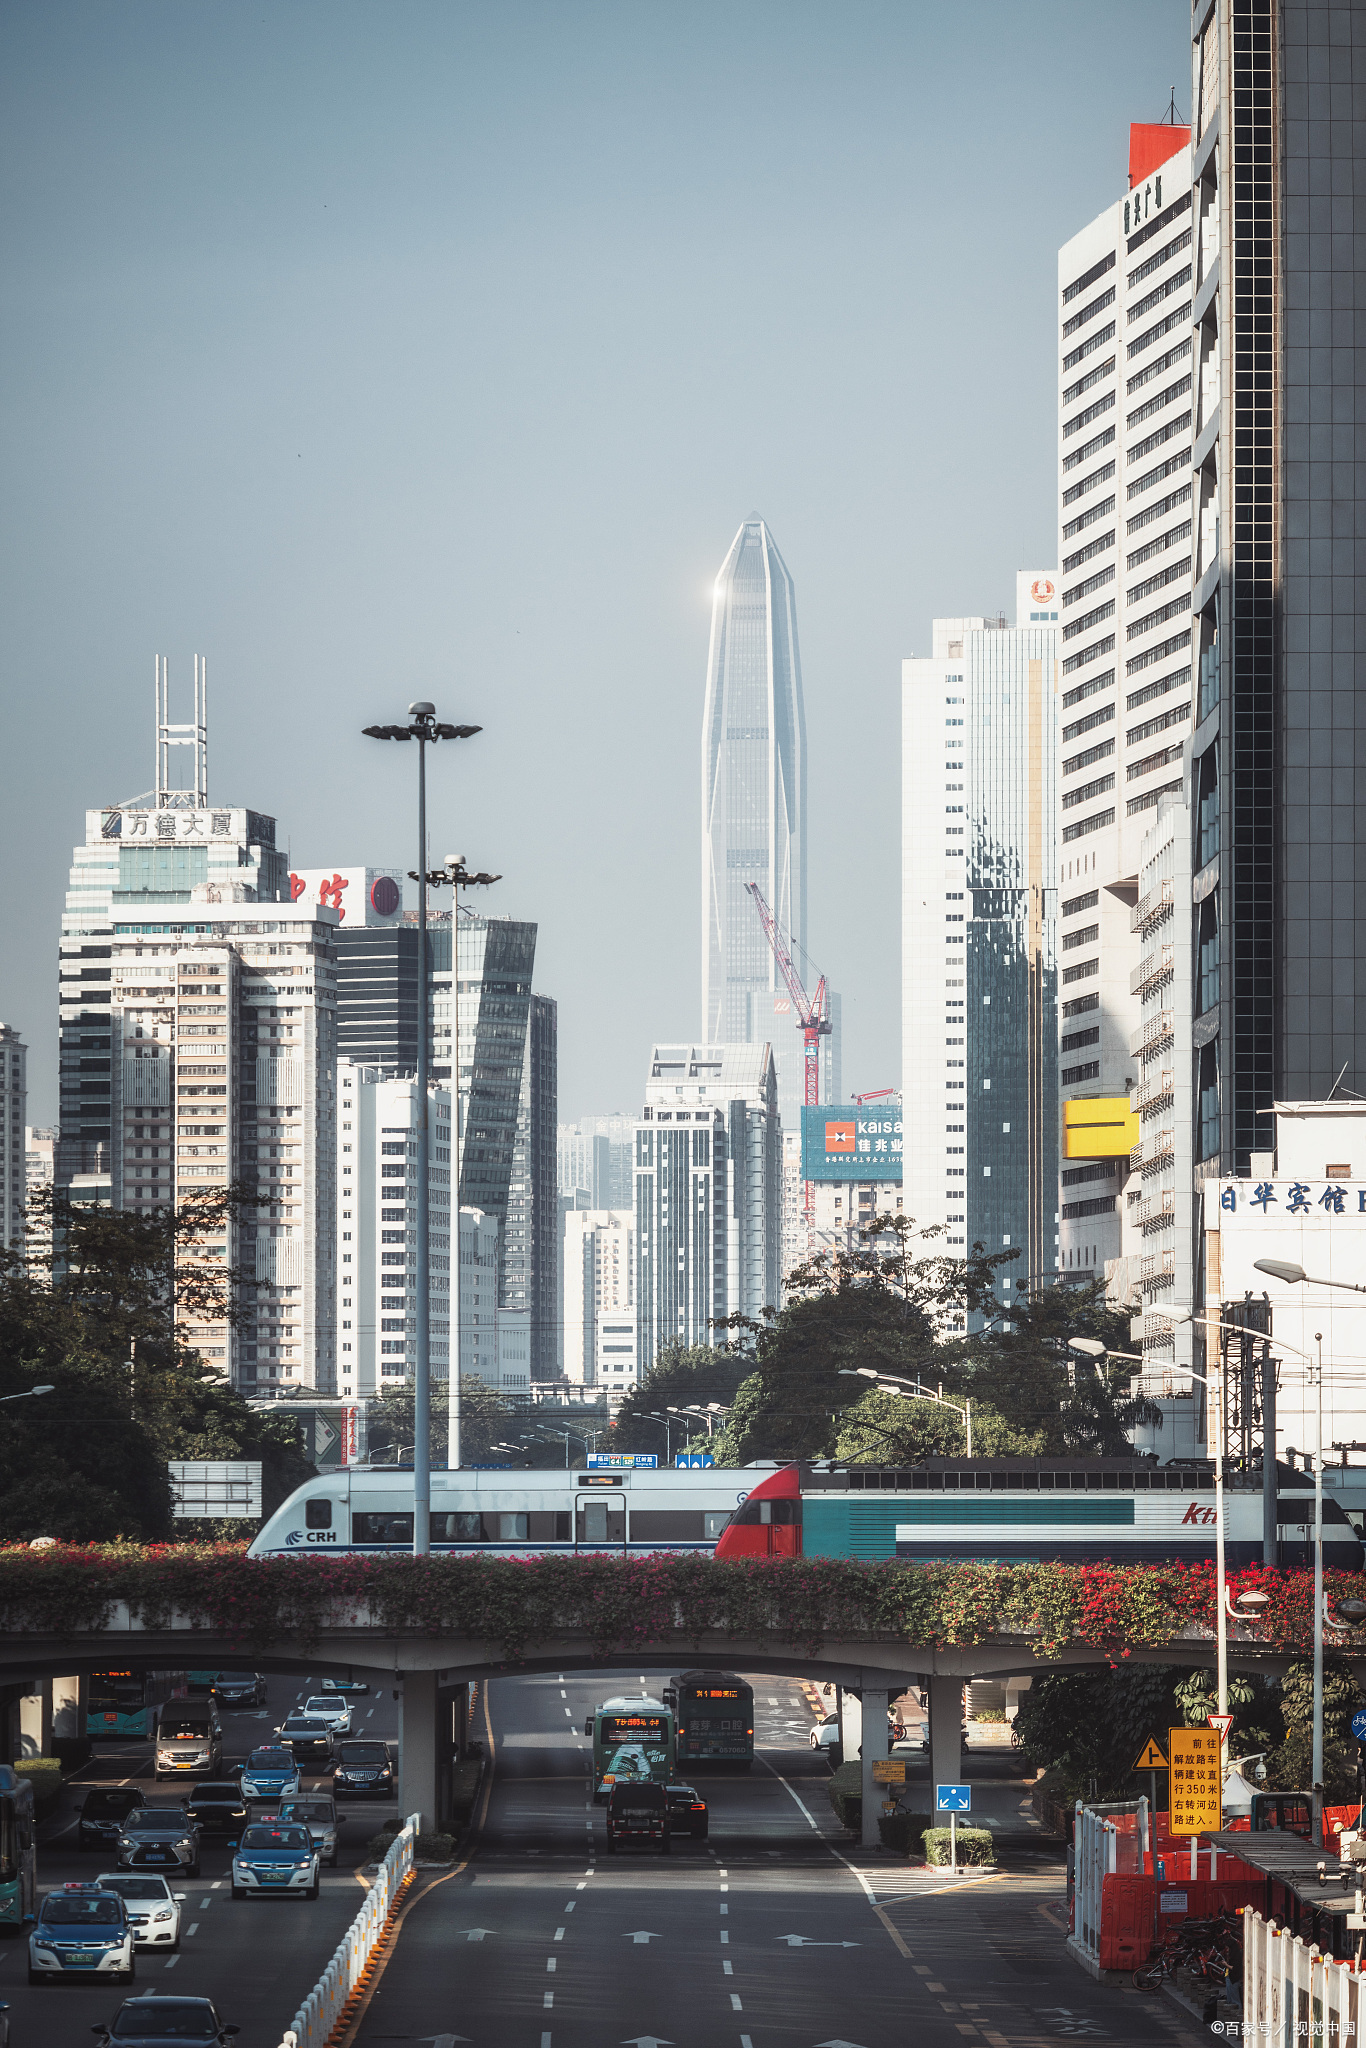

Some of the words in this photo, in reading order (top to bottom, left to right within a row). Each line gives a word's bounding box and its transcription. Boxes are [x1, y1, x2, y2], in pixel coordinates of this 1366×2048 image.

[128, 812, 232, 837] 万德大厦
[858, 1138, 903, 1153] 佳兆业
[1221, 1182, 1348, 1214] 日华宾馆
[306, 1532, 337, 1543] CRH
[1192, 1738, 1217, 1749] 前往
[1174, 1754, 1217, 1765] 解放路车
[1174, 1769, 1217, 1780] 辆建议直
[1174, 1784, 1218, 1795] 行350米
[1174, 1799, 1218, 1811] 右转河边
